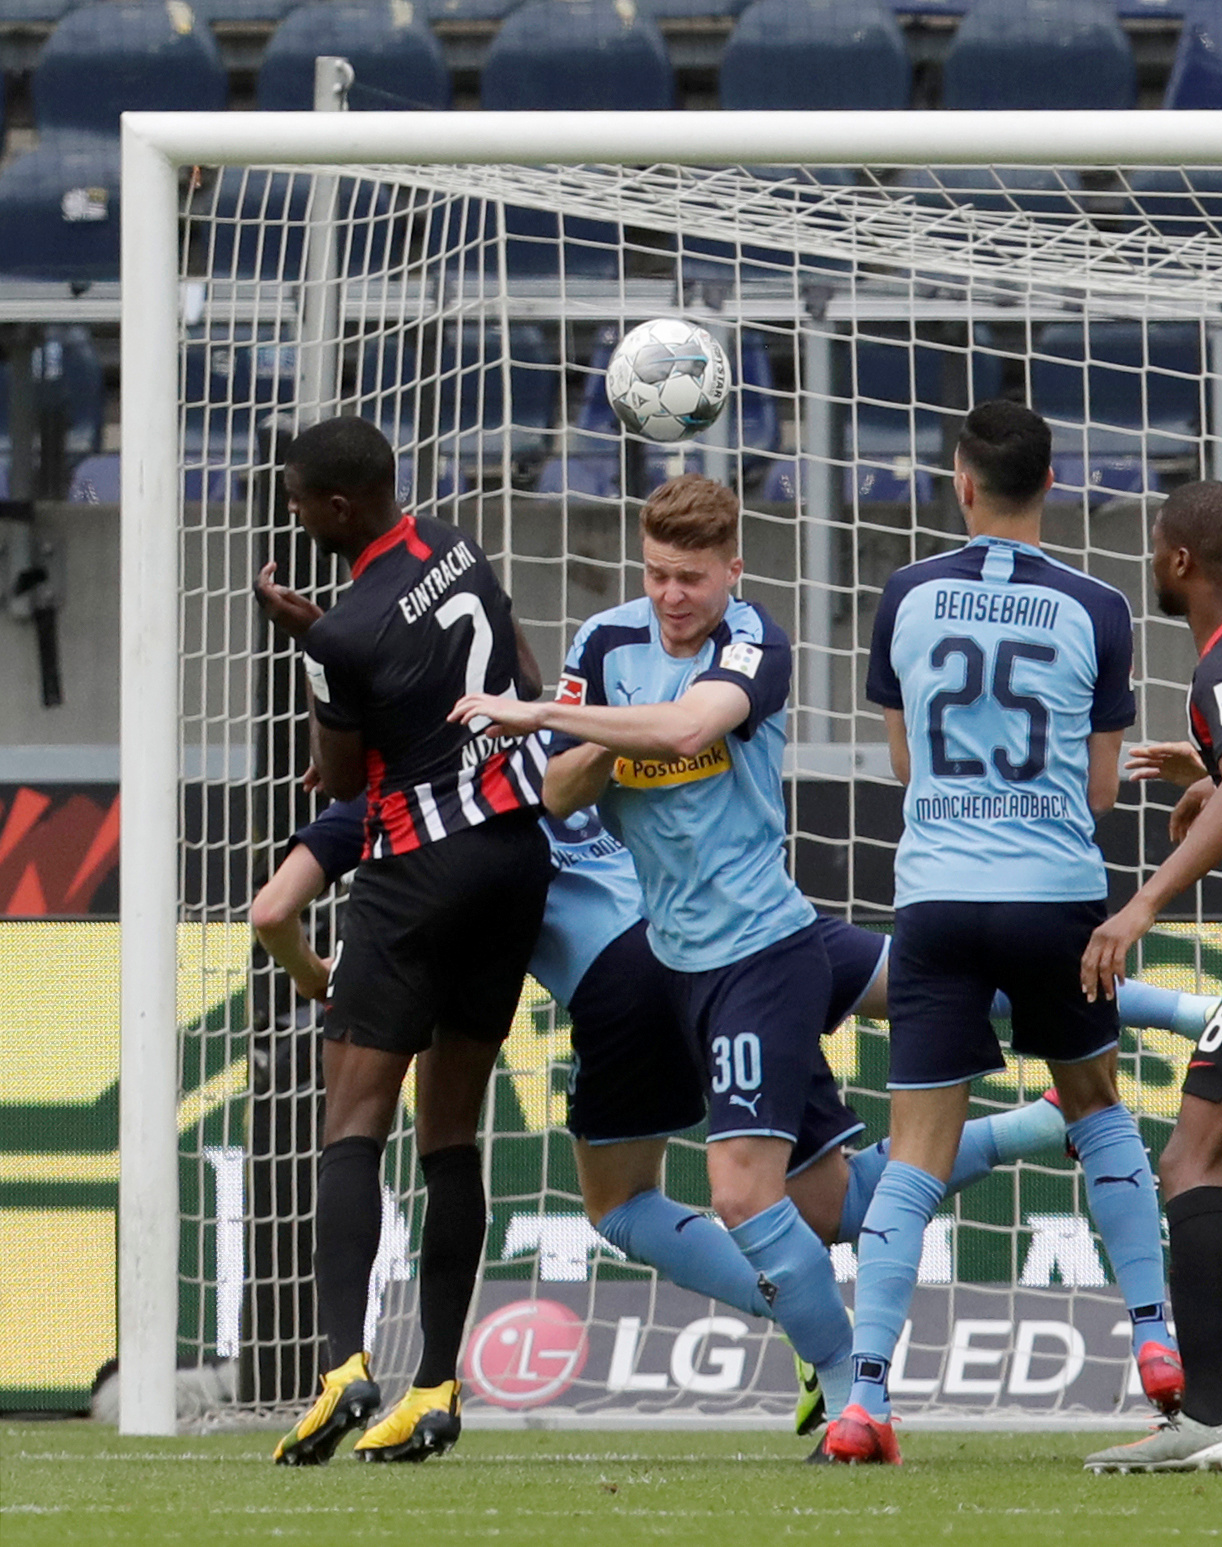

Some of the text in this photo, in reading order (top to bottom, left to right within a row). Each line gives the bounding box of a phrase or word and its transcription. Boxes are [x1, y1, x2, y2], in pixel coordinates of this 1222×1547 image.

[398, 540, 477, 625] EINTRACHT
[934, 590, 1059, 631] BENSEBAINI
[927, 634, 1058, 783] 25
[712, 1031, 763, 1094] 30
[606, 1316, 750, 1393] LG
[888, 1319, 1086, 1395] LED
